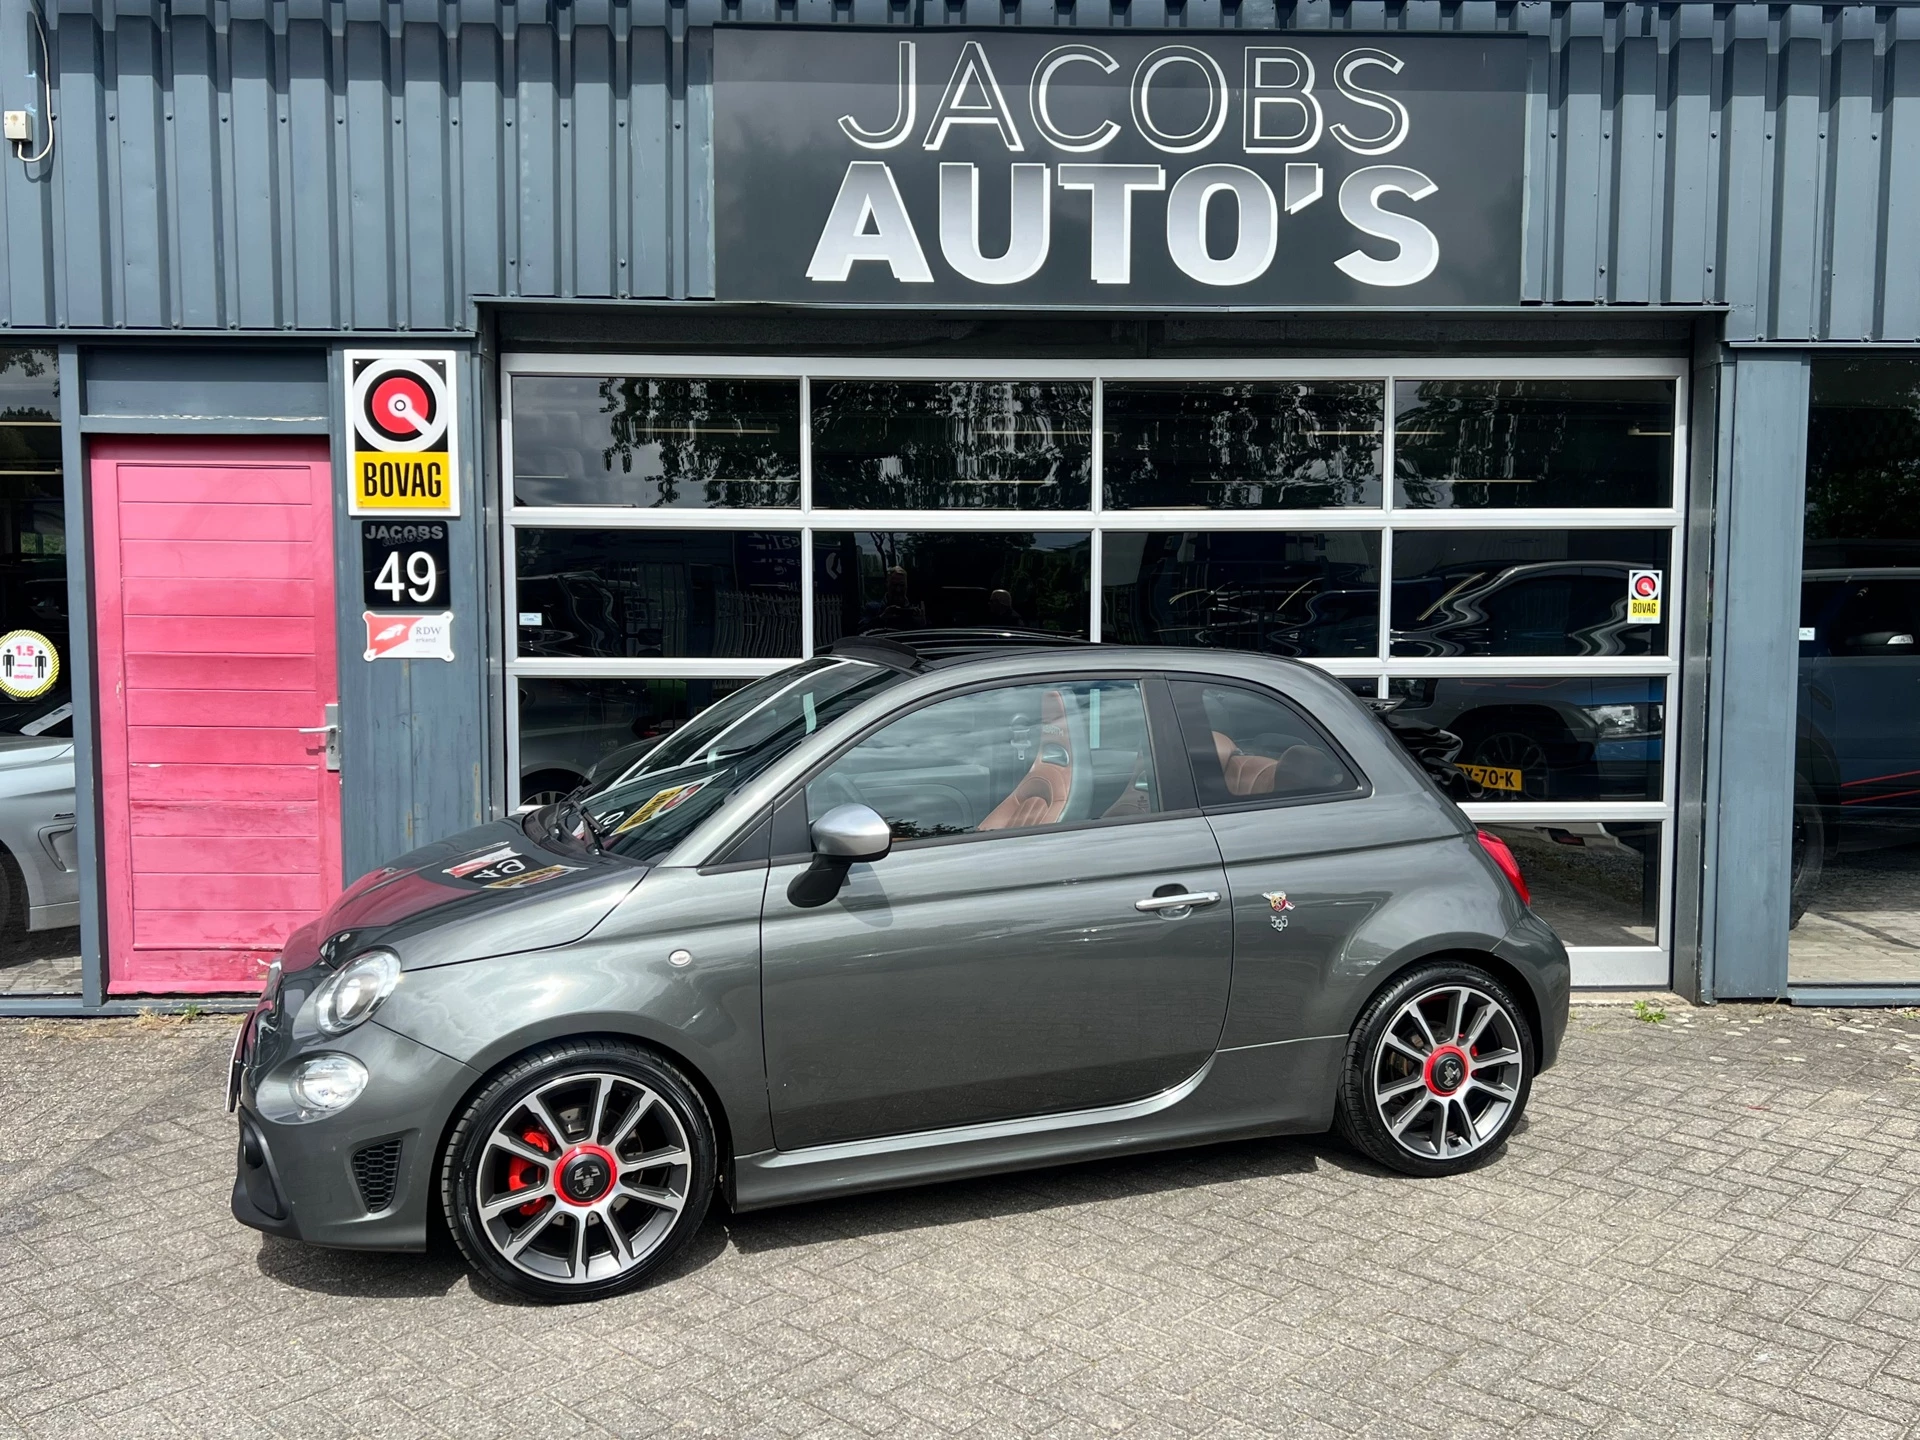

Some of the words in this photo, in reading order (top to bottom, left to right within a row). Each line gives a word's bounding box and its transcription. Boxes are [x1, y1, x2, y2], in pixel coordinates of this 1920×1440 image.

[838, 41, 1410, 154] JACOBS
[805, 161, 1440, 287] AUTO'S
[363, 461, 443, 498] BOVAG
[364, 525, 444, 540] JACOBS
[374, 551, 437, 603] 49
[1632, 602, 1656, 614] BOVAG
[415, 626, 442, 636] RDW
[15, 645, 35, 656] 1.5
[1270, 915, 1289, 932] 595
